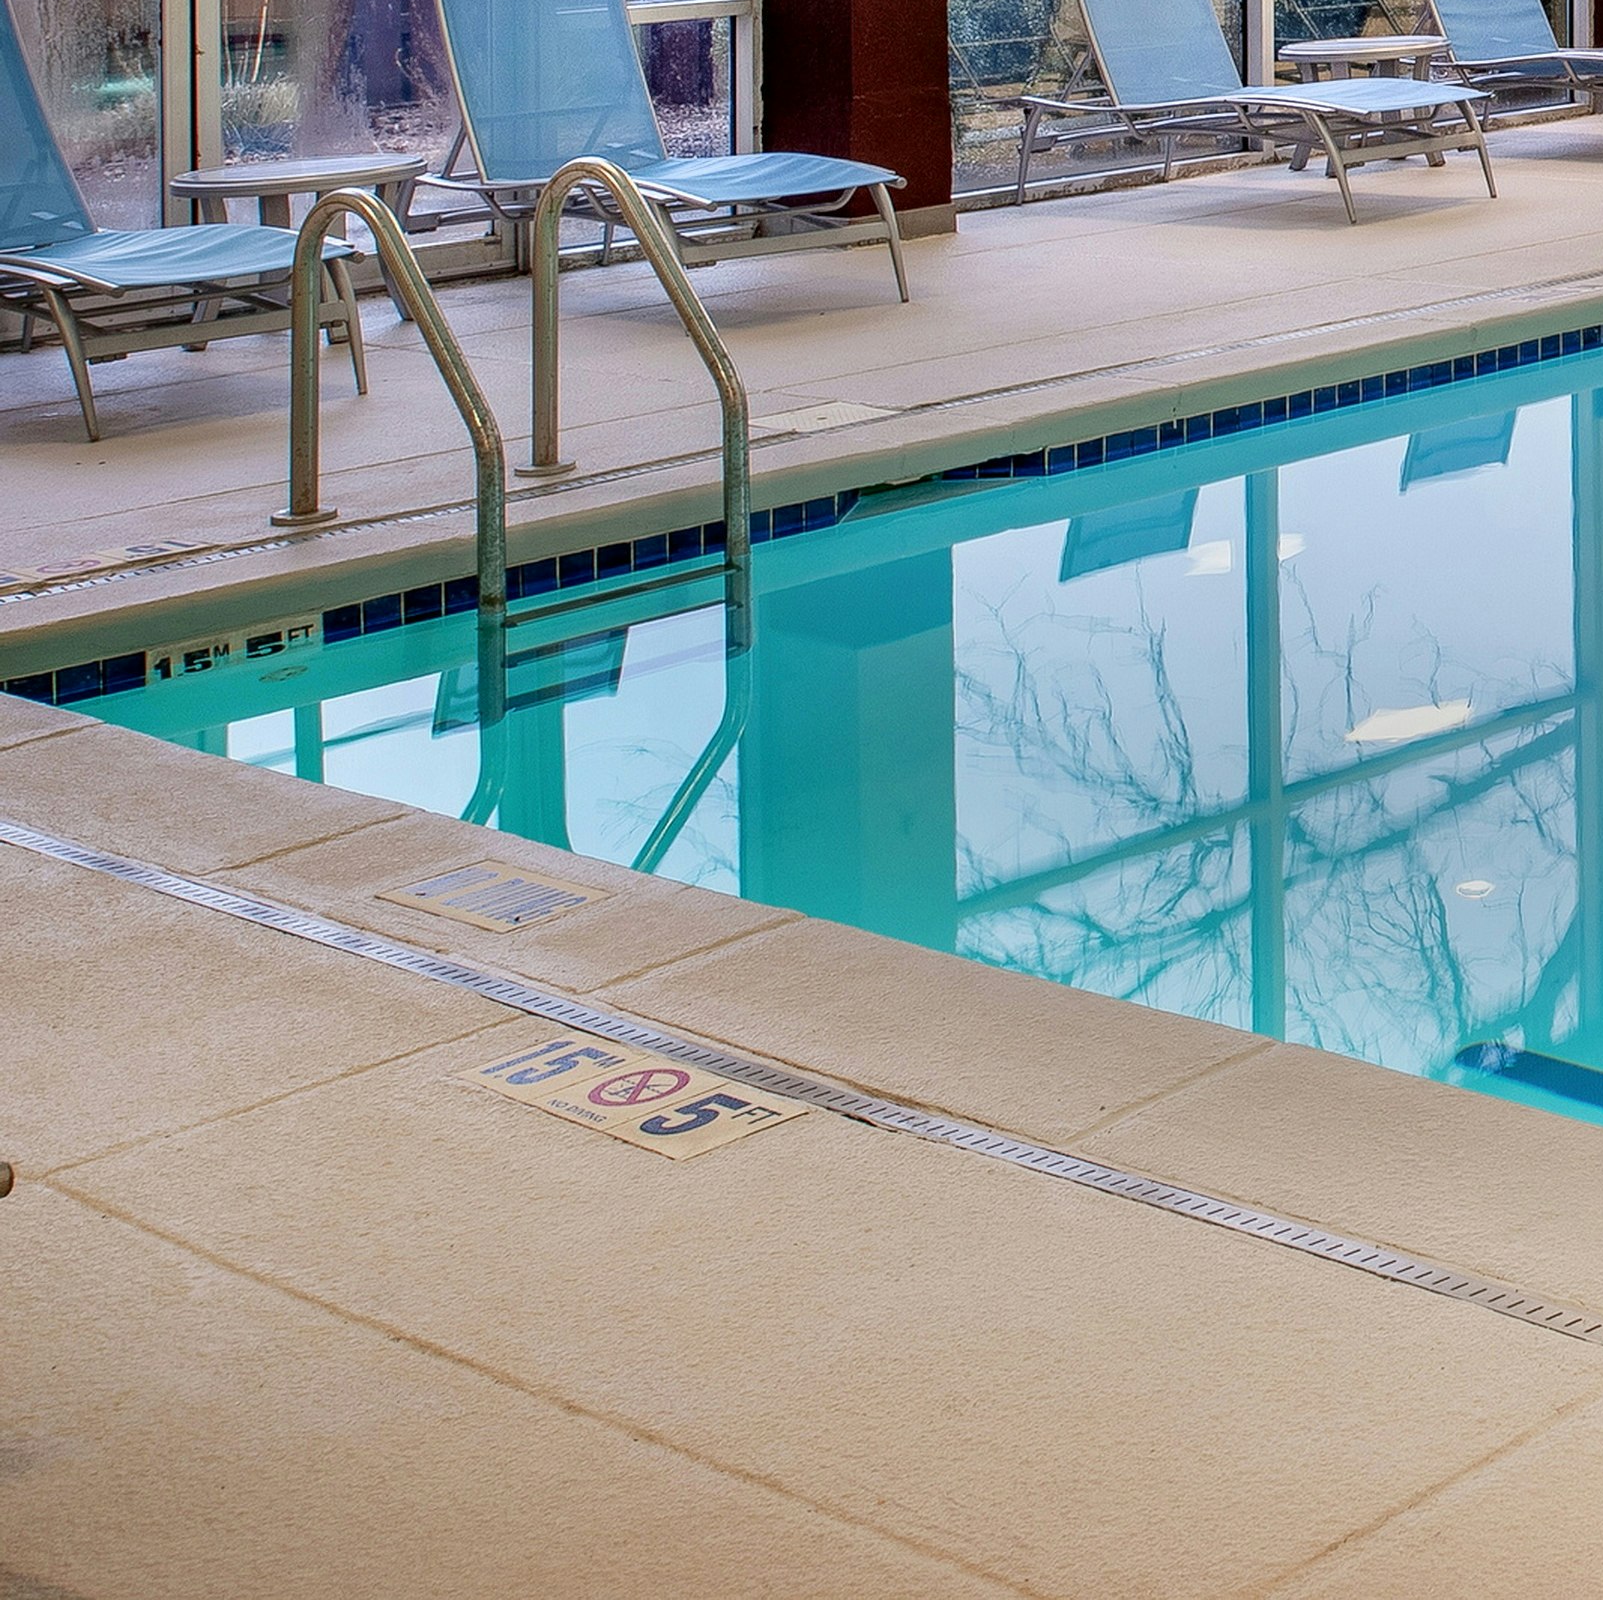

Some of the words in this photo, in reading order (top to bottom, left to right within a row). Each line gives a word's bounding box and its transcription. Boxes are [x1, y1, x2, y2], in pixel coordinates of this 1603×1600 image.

[401, 867, 499, 899] NO
[439, 877, 588, 926] DIVING
[548, 1099, 566, 1109] NO
[566, 1105, 608, 1123] DIVING
